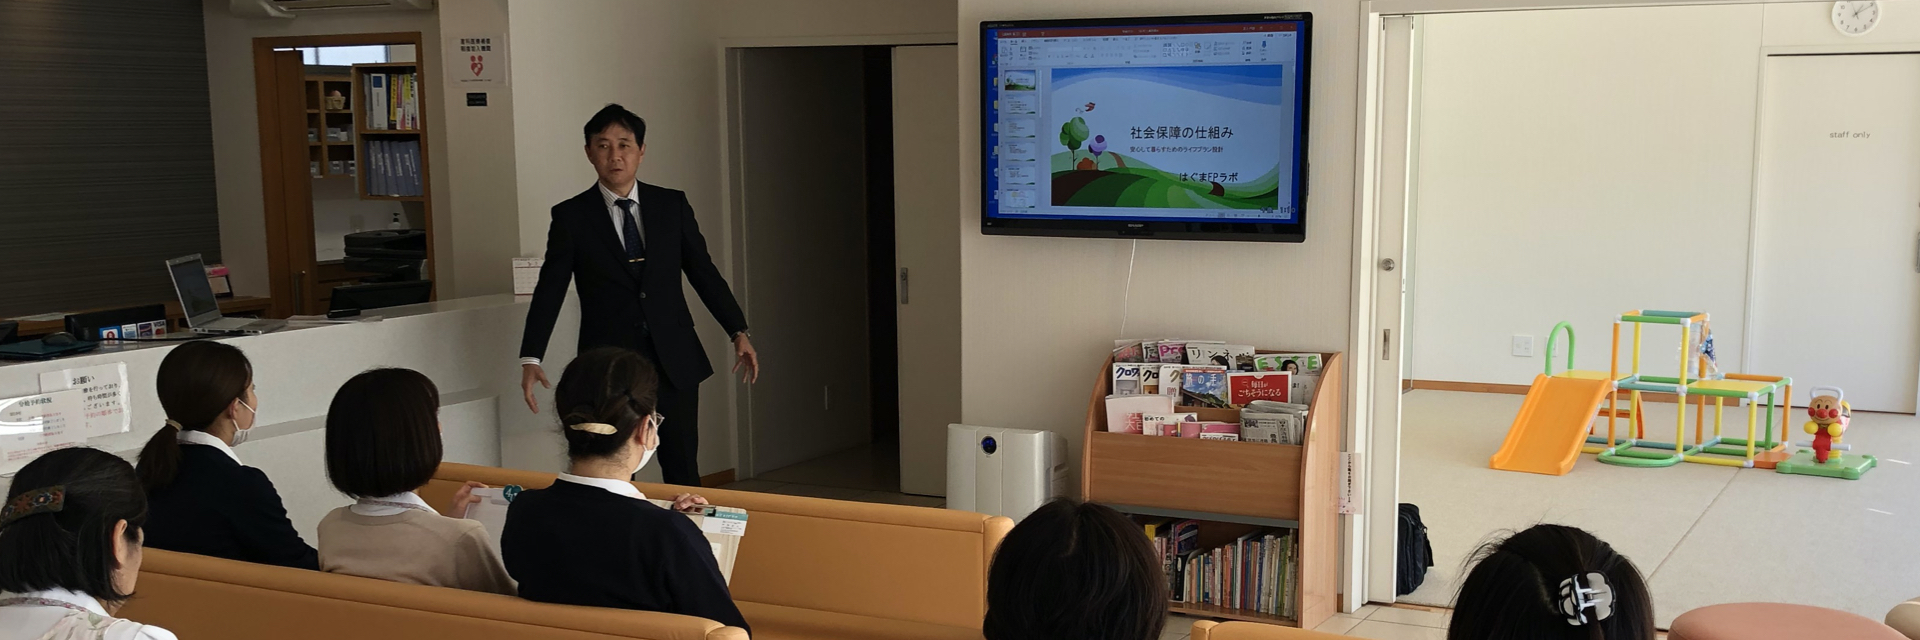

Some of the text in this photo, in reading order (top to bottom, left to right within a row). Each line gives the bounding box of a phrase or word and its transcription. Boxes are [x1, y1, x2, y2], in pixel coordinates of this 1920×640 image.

[1130, 126, 1234, 140] 社会保障の仕組み
[1829, 131, 1871, 139] staff only
[1179, 172, 1238, 182] はぐまFPラボ
[1116, 367, 1140, 379] クロワ
[72, 376, 95, 385] お願い
[1238, 388, 1282, 397] ごちそうになる
